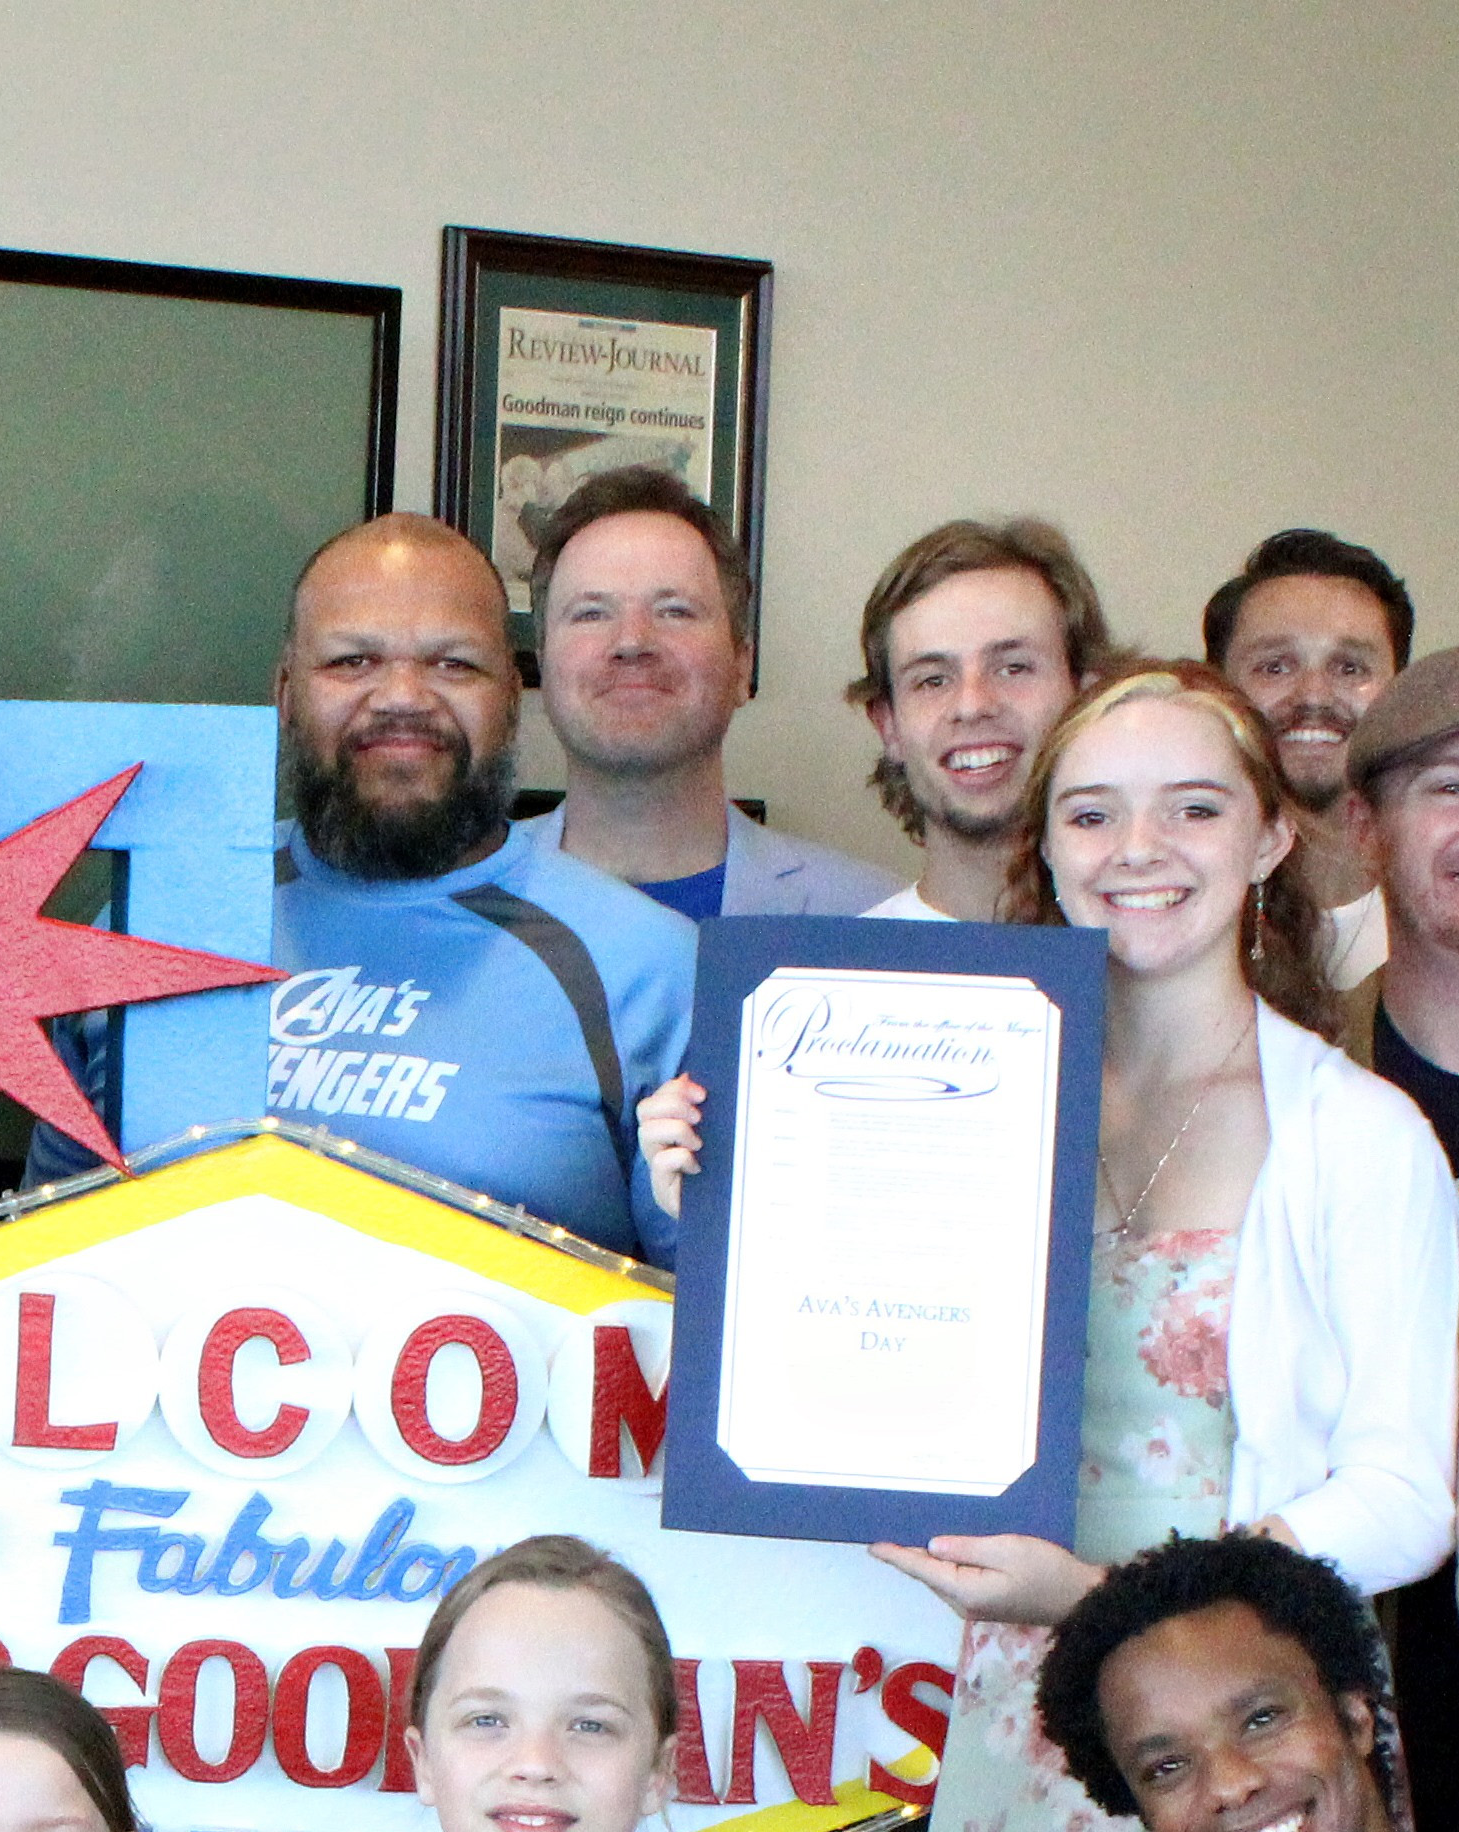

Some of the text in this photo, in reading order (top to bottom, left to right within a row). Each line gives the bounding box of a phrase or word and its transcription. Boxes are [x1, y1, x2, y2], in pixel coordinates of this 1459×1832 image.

[507, 327, 707, 377] REVIEW-JOURNAL
[502, 393, 706, 430] Goodman reign continues
[757, 987, 997, 1072] Proclamation
[266, 1044, 461, 1122] ENGERS
